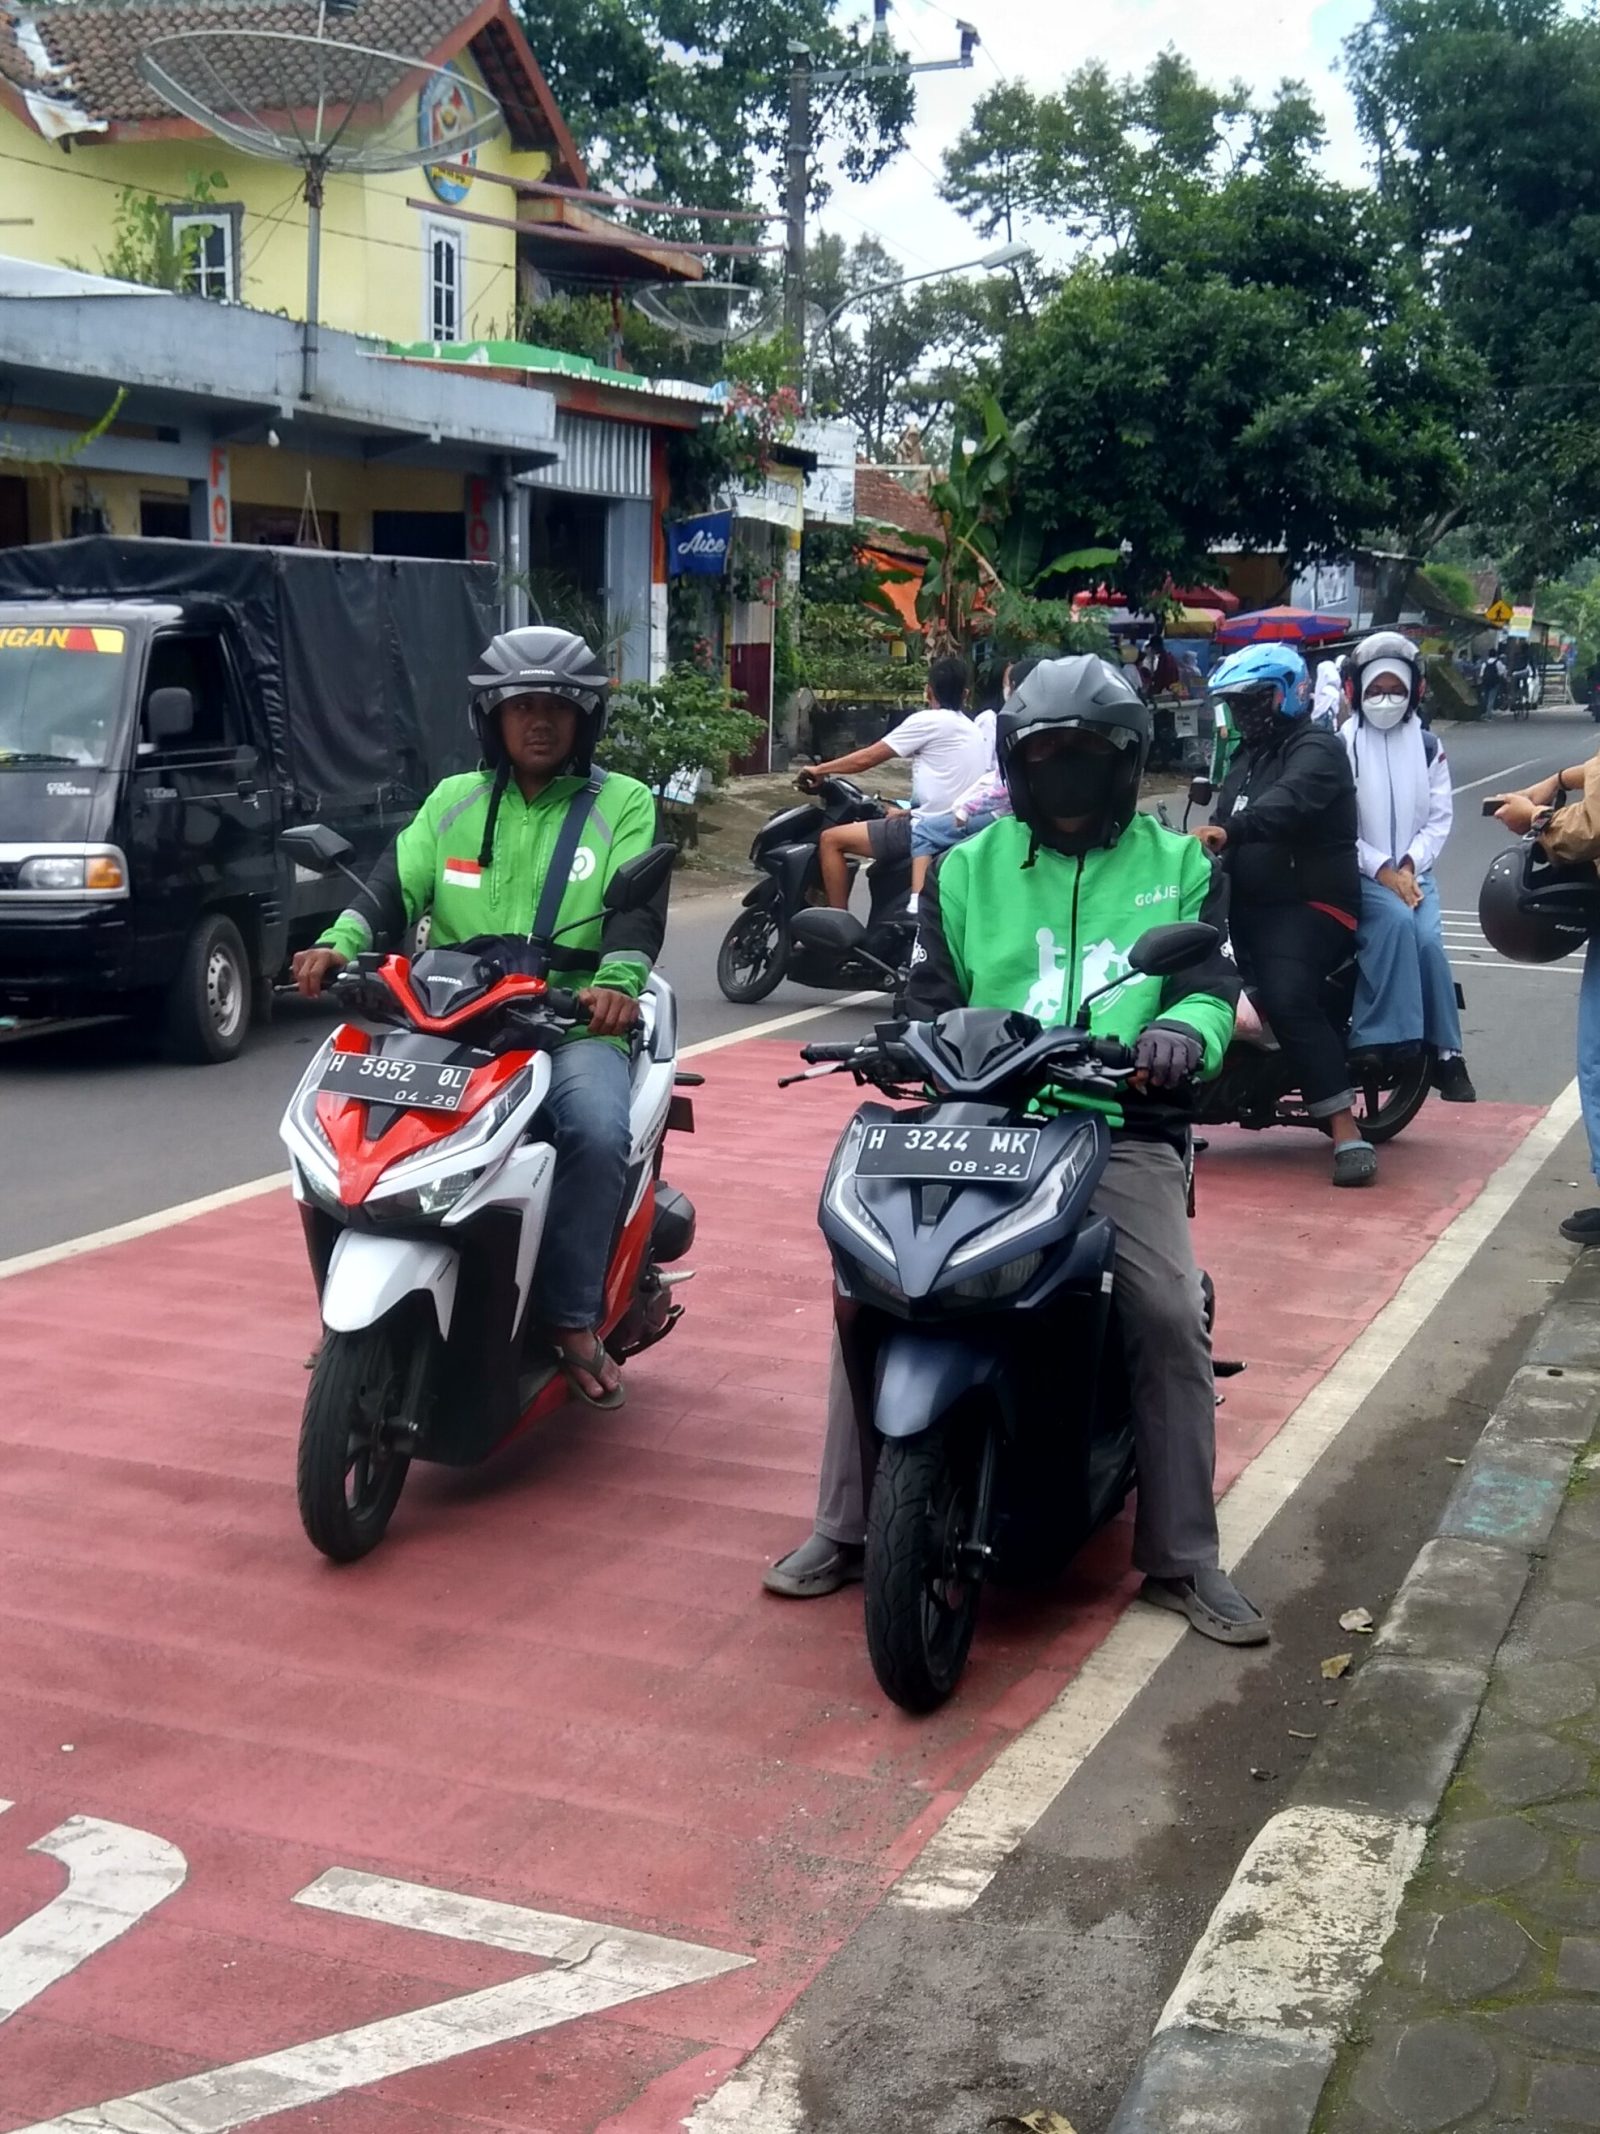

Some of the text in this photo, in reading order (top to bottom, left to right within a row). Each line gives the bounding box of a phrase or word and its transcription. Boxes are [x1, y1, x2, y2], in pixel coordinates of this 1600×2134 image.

[210, 447, 227, 545] FO
[678, 530, 726, 554] Aice
[426, 975, 464, 986] HONDA
[329, 1055, 347, 1072] H
[359, 1058, 416, 1082] 5952
[868, 1129, 1030, 1154] H 3244 MK
